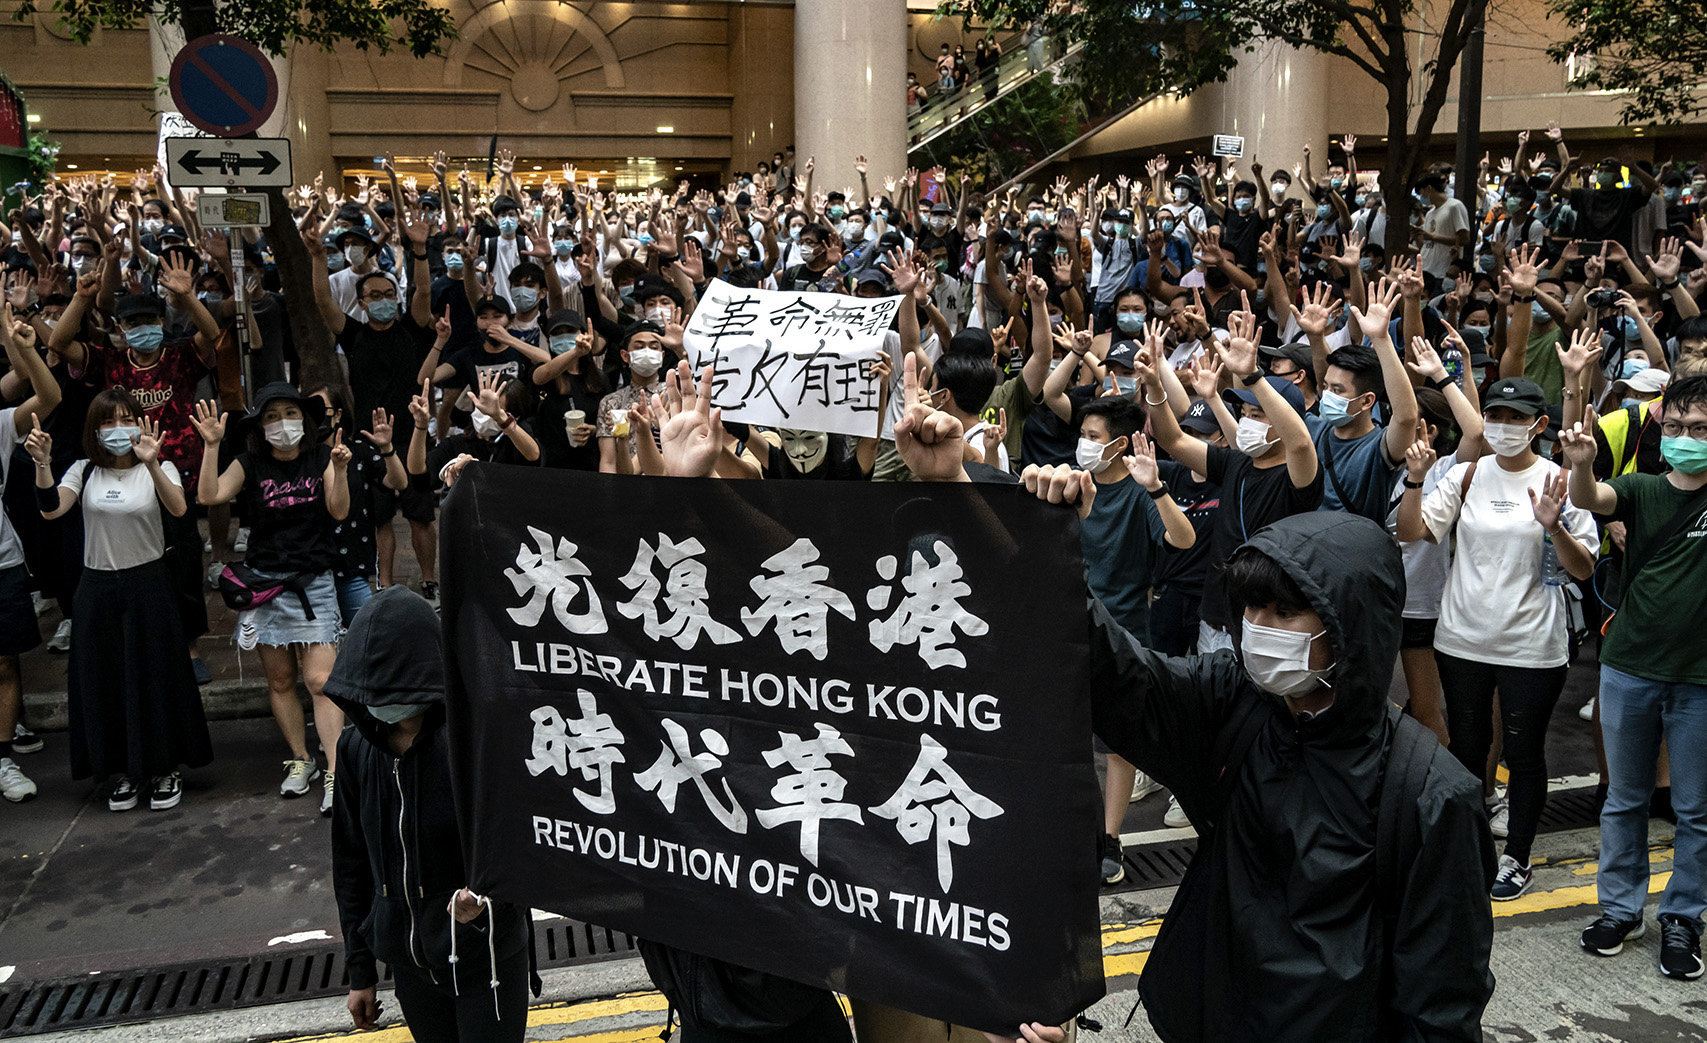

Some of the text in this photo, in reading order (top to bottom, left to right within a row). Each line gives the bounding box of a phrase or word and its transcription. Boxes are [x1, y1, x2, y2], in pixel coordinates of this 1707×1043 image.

[689, 295, 897, 352] 革命無罪
[260, 476, 323, 500] Daisy
[504, 526, 989, 670] 光復香港
[511, 640, 1002, 732] LIBERATE HONG KONG
[525, 688, 1004, 895] 時代革命
[532, 815, 1011, 951] REVOLUTION OF OUR TIMES
